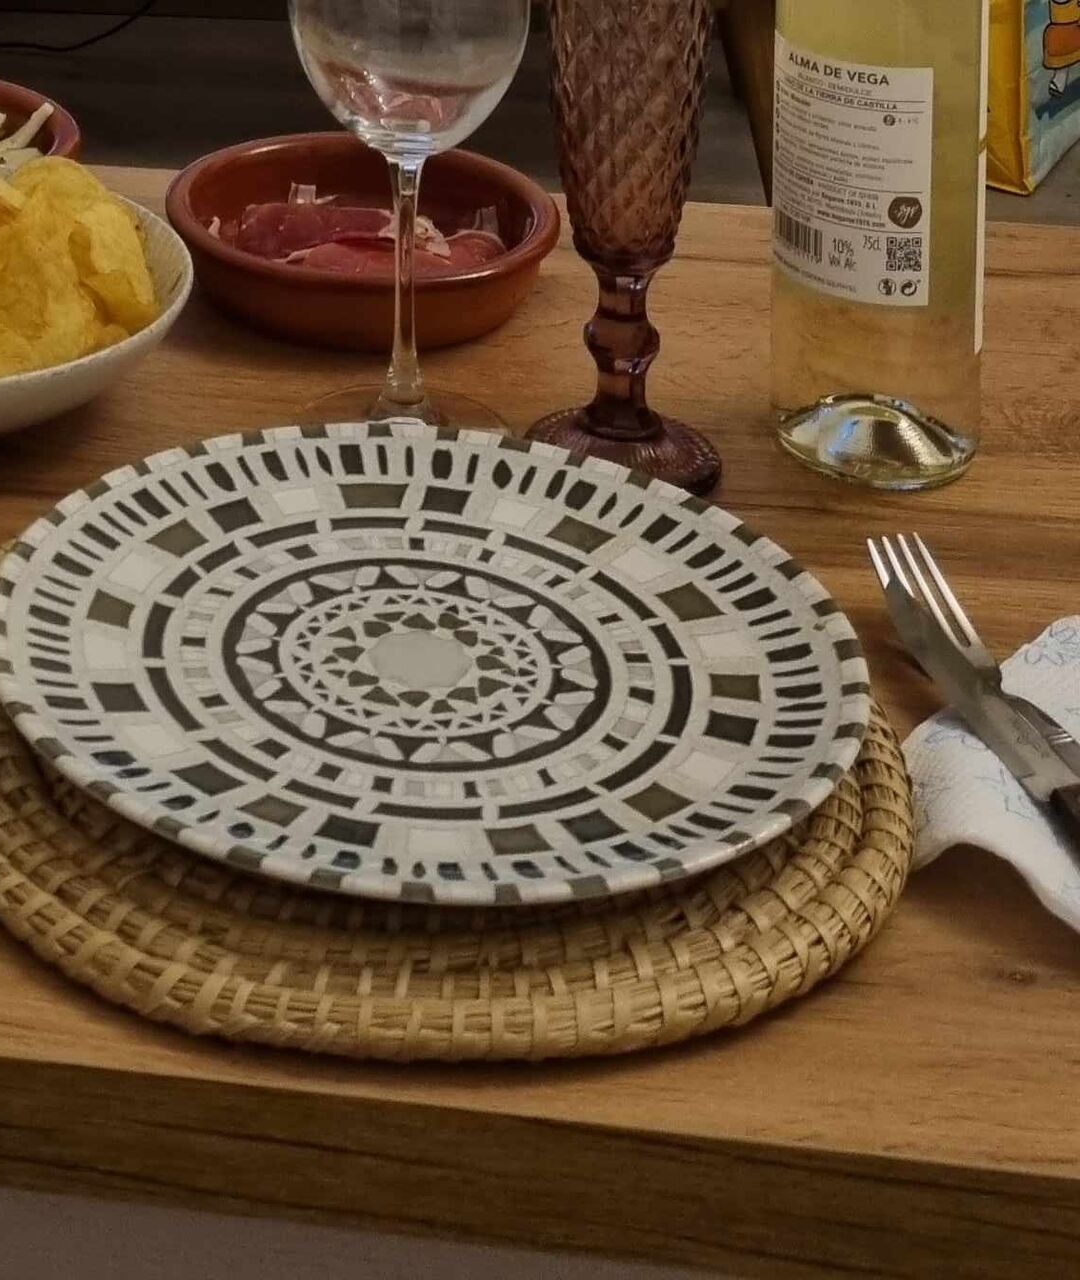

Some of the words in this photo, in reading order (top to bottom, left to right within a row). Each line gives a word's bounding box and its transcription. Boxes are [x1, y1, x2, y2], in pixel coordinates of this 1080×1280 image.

[788, 50, 820, 74] ALMA
[823, 64, 842, 79] DE
[846, 69, 890, 86] VEGA
[856, 99, 898, 110] CASTILLA
[832, 238, 855, 257] 10%
